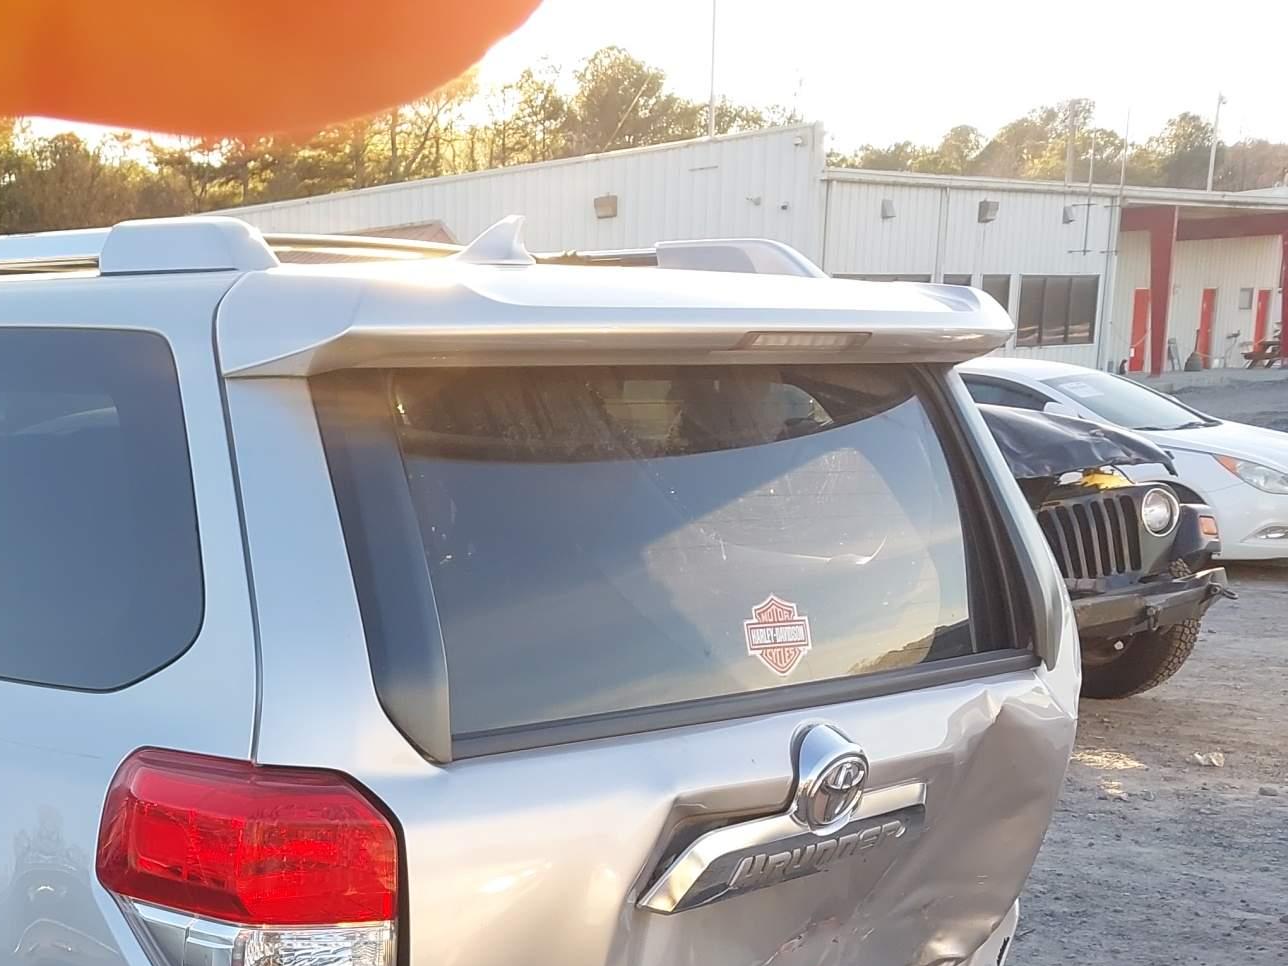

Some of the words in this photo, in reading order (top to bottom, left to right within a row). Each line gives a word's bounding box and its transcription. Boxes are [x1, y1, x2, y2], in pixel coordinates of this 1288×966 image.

[757, 607, 792, 623] MOTOR
[751, 624, 806, 644] HARLEY-DAVIDSON
[764, 647, 797, 666] CYCLES
